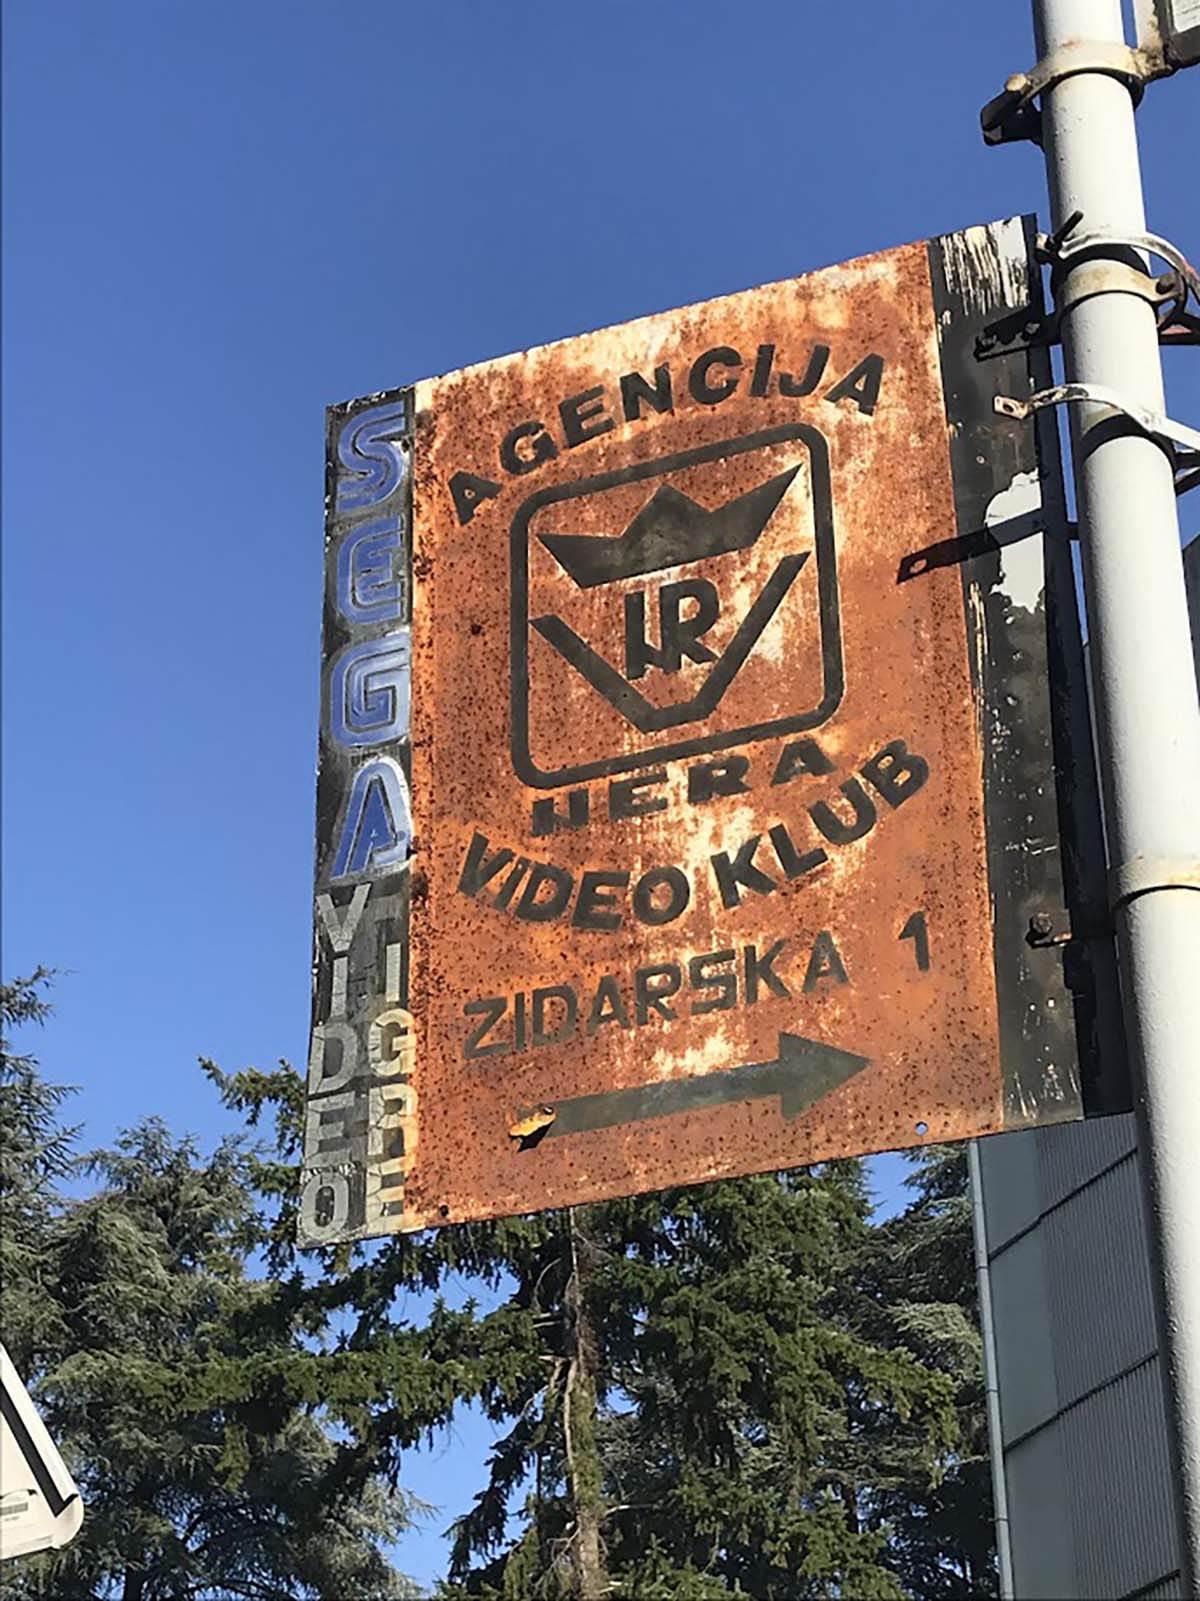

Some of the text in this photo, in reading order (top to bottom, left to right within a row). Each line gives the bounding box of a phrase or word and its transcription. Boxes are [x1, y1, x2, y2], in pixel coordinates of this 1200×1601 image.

[447, 344, 885, 526] AGENCIJA
[329, 402, 413, 879] SEGA
[457, 739, 930, 932] VIDEO KLUB
[462, 910, 932, 1061] ZIDARSKA 1
